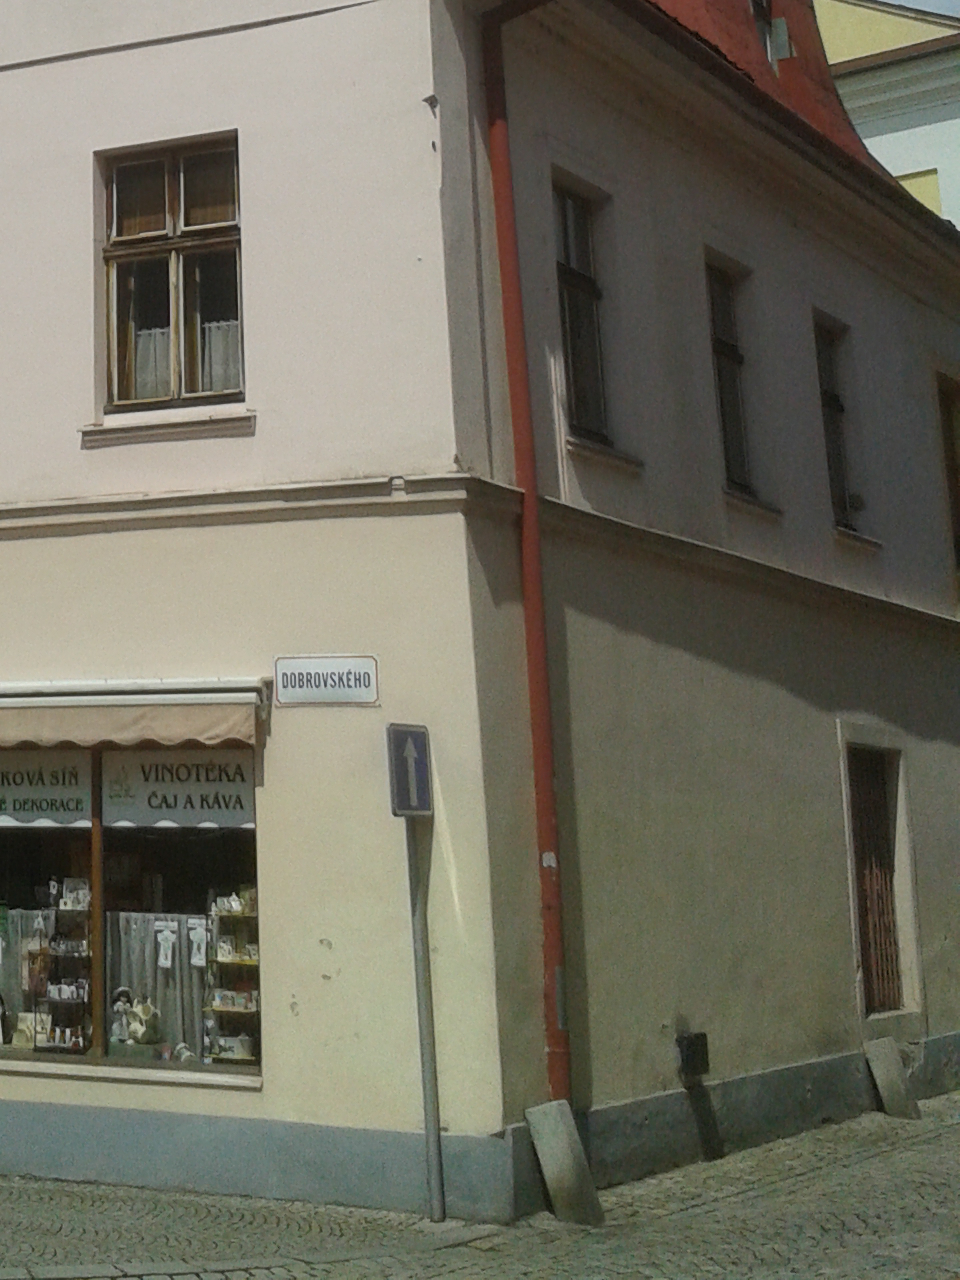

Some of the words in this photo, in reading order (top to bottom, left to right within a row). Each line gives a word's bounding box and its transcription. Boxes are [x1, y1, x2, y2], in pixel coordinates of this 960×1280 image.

[281, 668, 371, 689] DOBROVSKÉHO
[50, 766, 79, 787] SÍŇ
[140, 760, 247, 783] VINOTÉKA
[12, 798, 84, 813] DEKORACE
[147, 790, 178, 810] ČAJ
[183, 793, 195, 810] A
[200, 791, 244, 810] KÁVA
